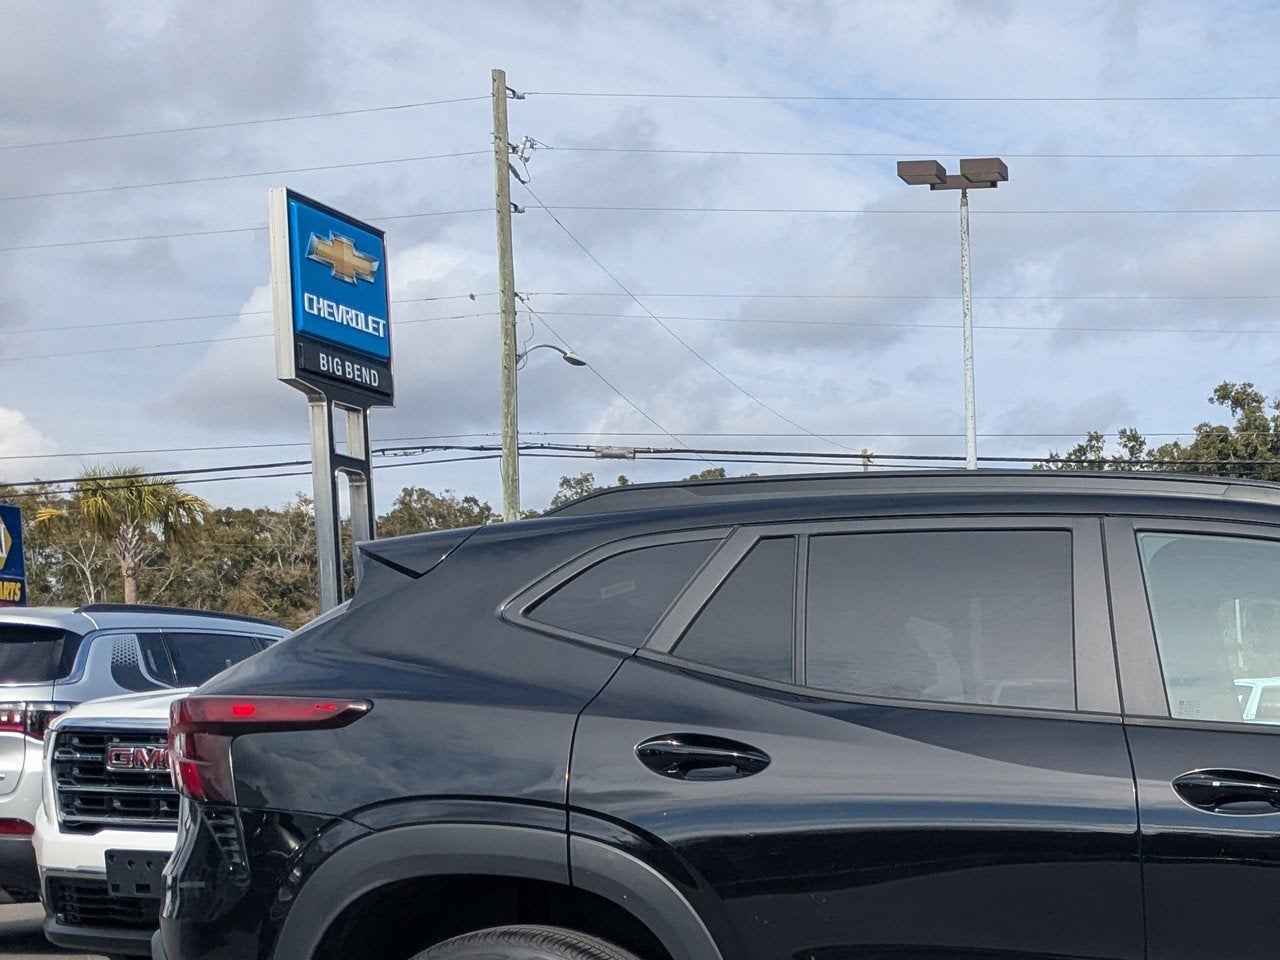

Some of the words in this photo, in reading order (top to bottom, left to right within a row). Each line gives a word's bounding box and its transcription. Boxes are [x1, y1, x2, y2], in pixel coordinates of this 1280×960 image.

[304, 292, 386, 338] CHEVROLET
[319, 353, 343, 376] BIG
[345, 361, 380, 387] BEND
[109, 747, 169, 769] GM
